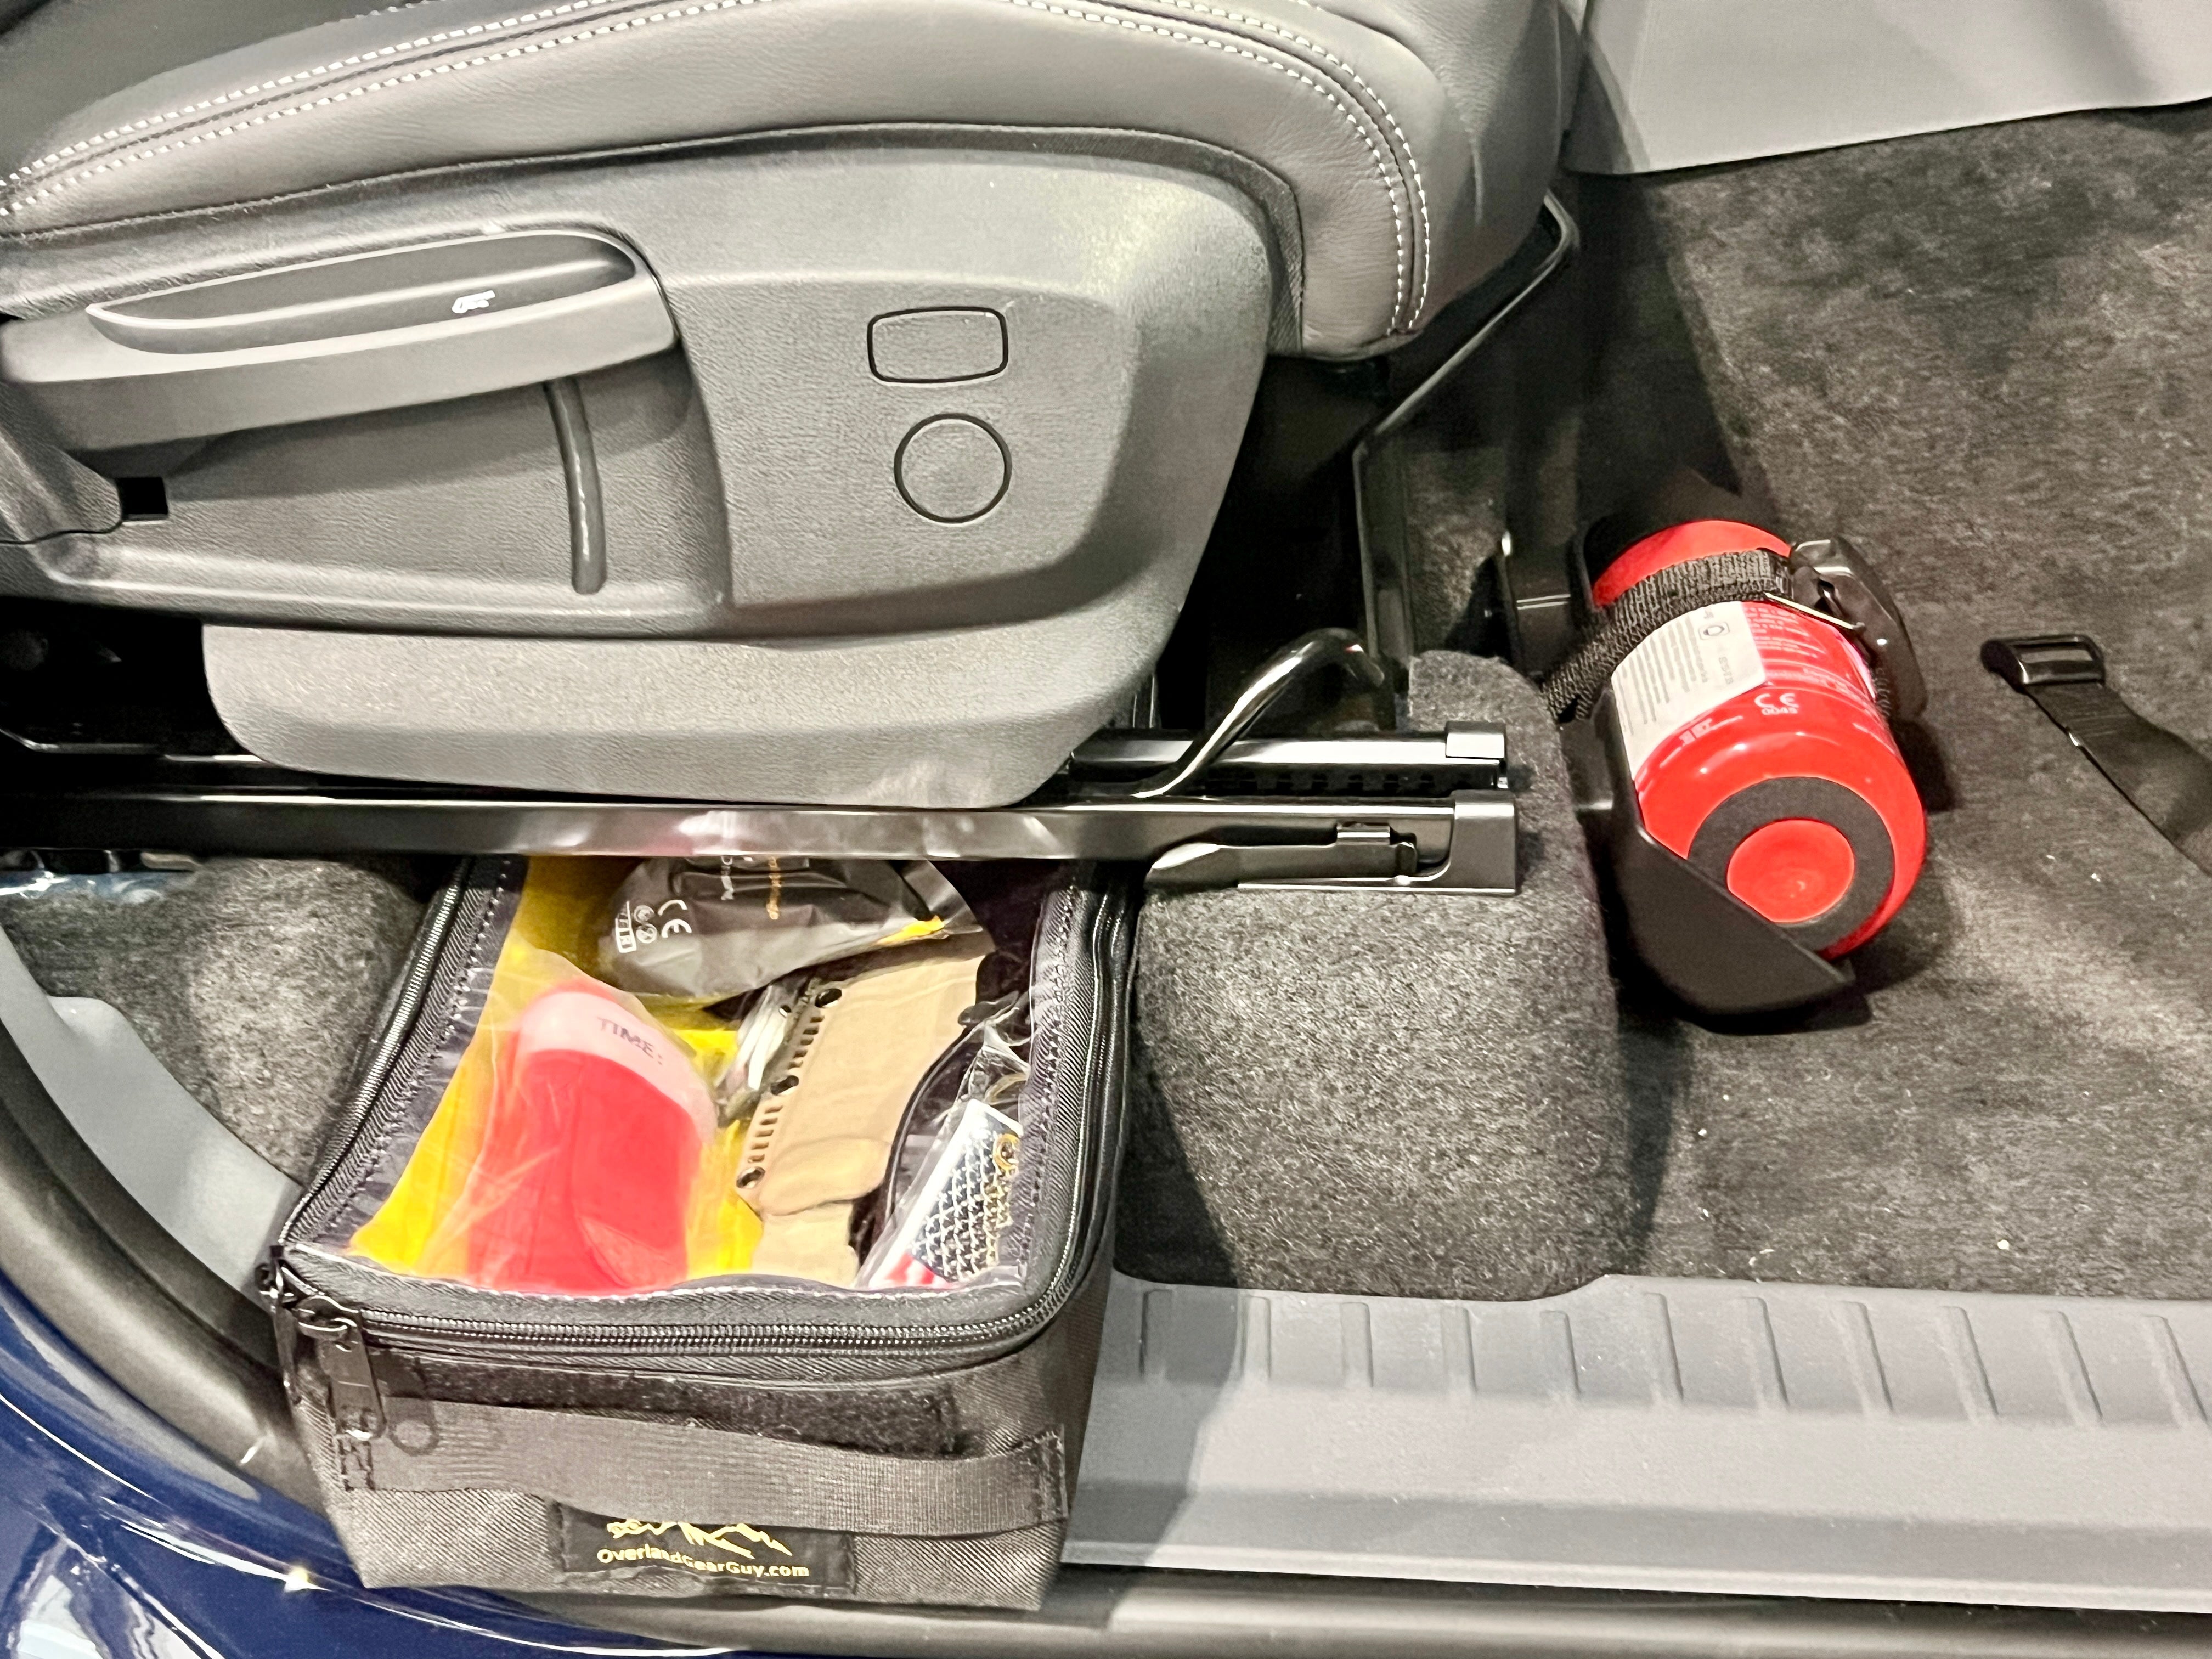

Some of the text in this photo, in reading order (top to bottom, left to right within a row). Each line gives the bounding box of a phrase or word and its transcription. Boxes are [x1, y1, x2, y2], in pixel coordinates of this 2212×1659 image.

[1754, 692, 1800, 709] CE
[658, 899, 692, 938] CE
[596, 1016, 663, 1065] TIME:
[596, 1543, 810, 1578] OverlandGearGuy.com
